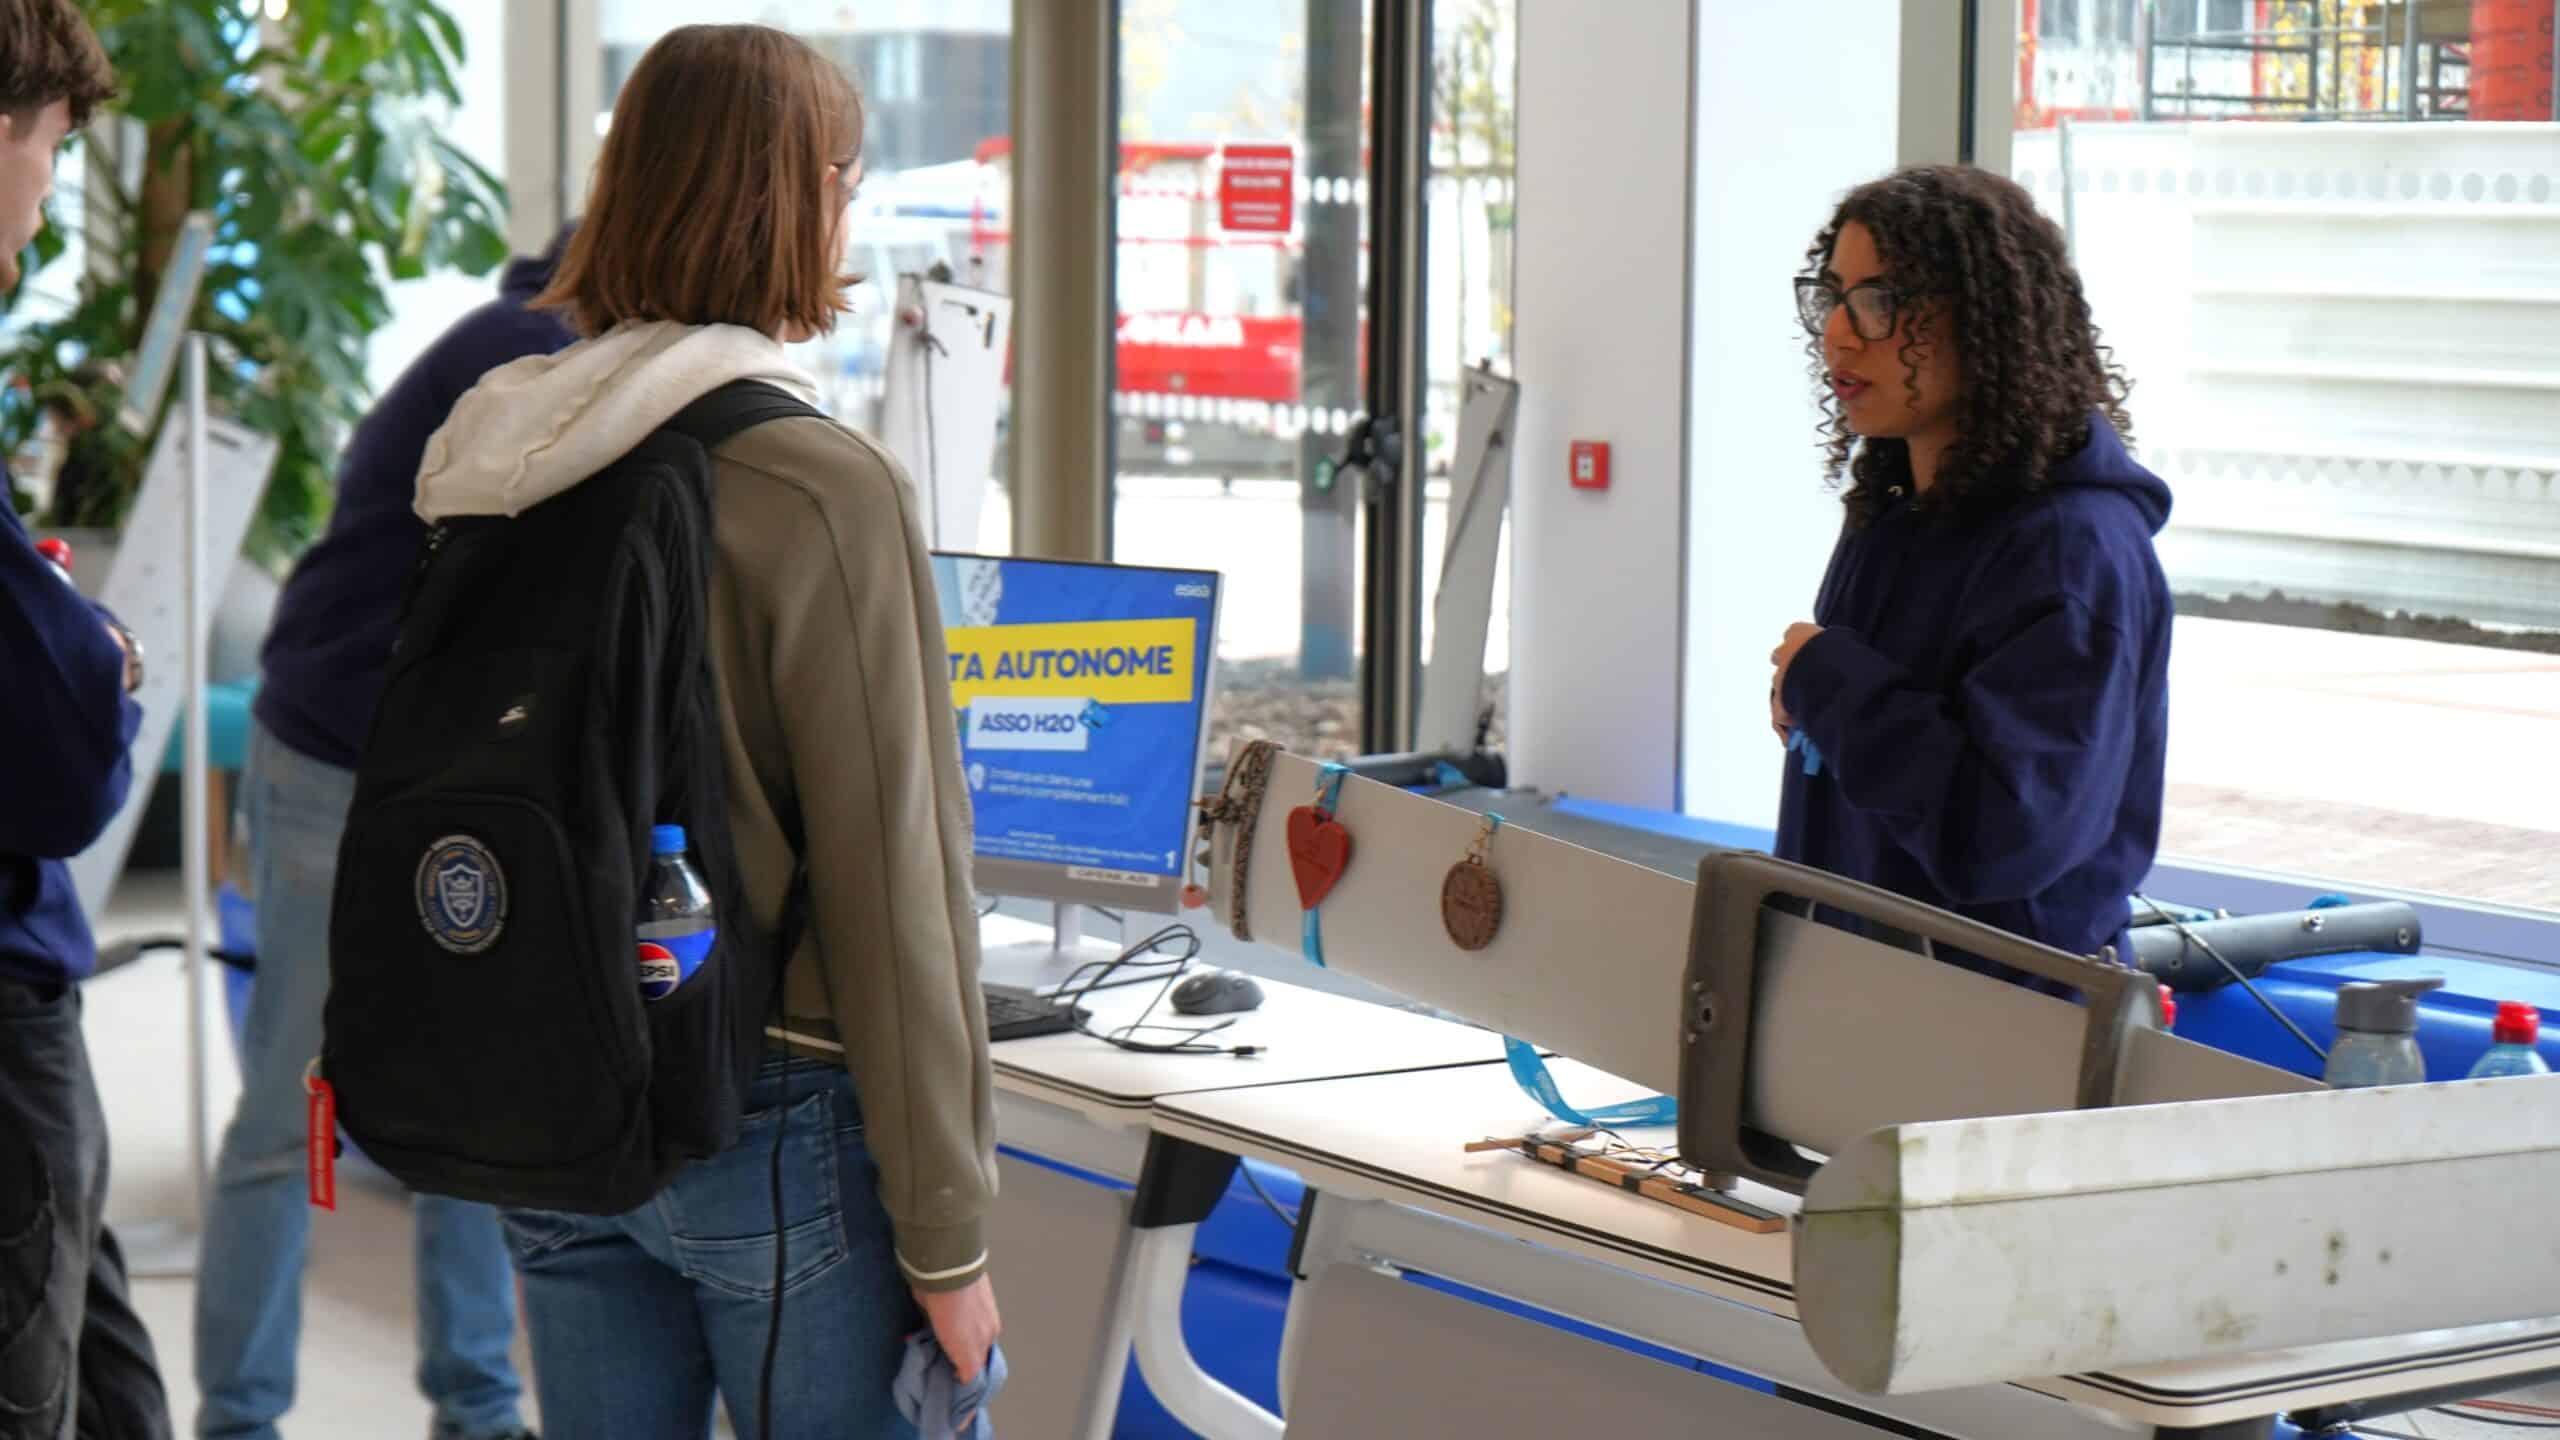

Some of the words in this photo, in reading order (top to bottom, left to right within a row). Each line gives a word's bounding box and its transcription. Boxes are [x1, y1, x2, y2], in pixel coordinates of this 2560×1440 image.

[993, 645, 1174, 680] AUTONOME
[978, 713, 1031, 733] ASSO
[1034, 713, 1076, 733] H2O
[1165, 850, 1177, 870] 1
